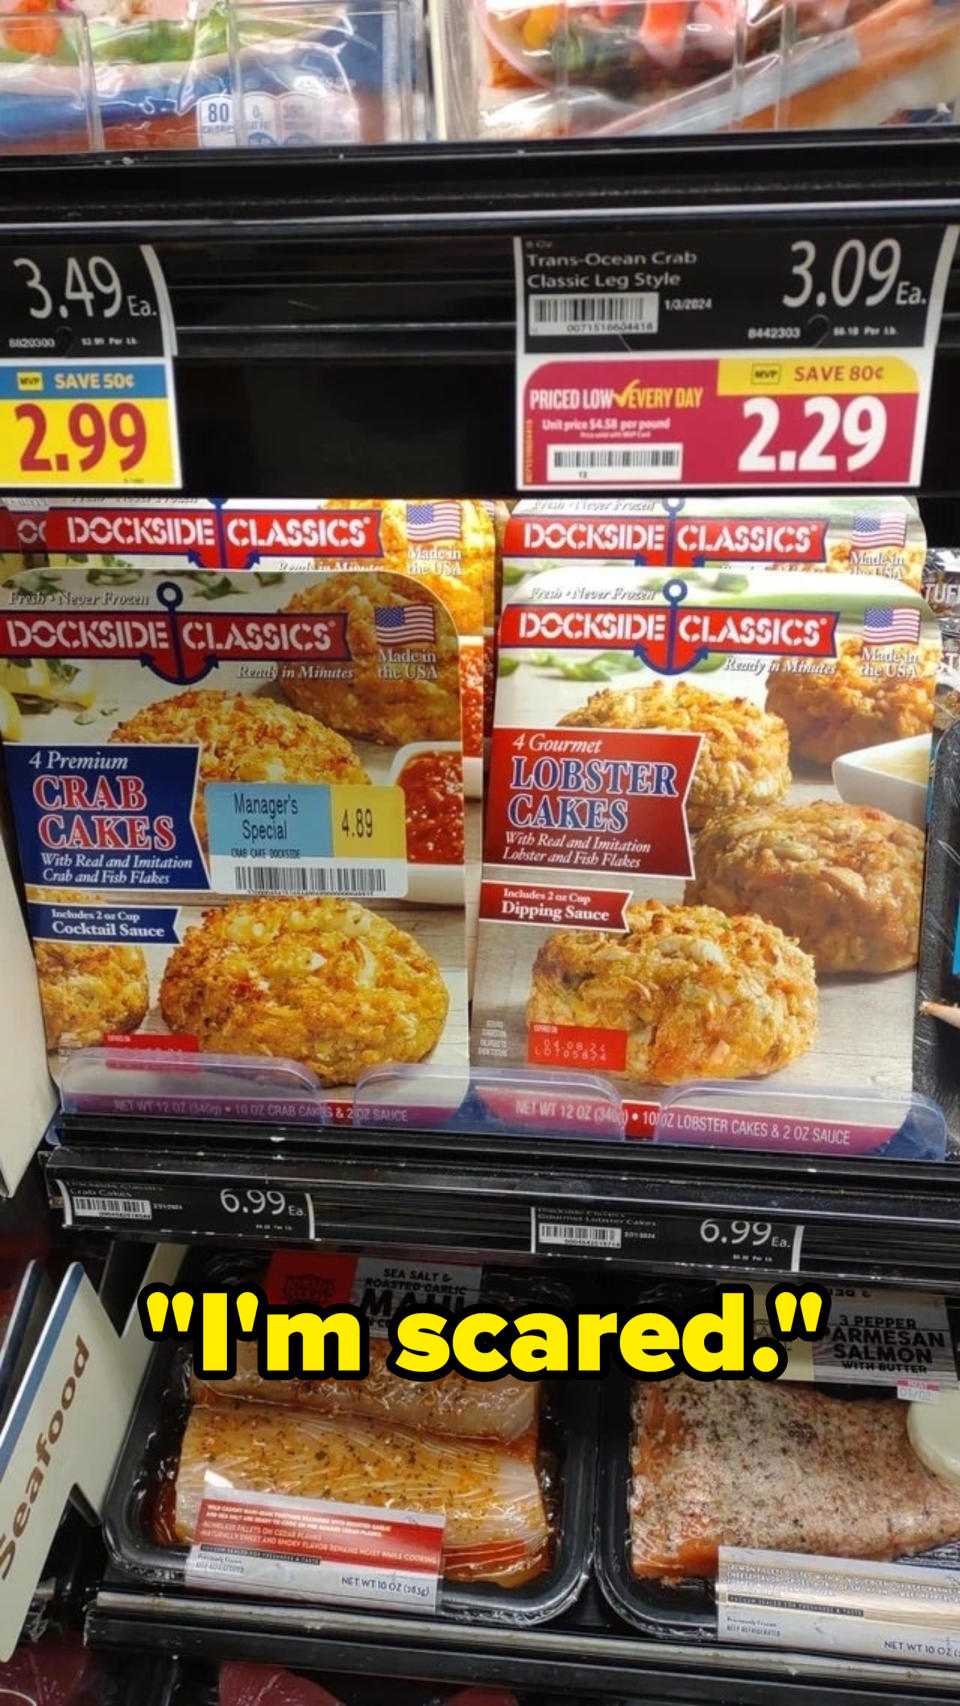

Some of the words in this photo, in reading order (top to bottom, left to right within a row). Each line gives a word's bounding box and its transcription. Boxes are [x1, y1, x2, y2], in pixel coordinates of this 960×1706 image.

[208, 103, 229, 122] 80
[526, 252, 646, 267] Trans-Ocean
[652, 251, 697, 265] Crab
[527, 273, 590, 288] Classic
[595, 273, 630, 289] Leg
[634, 272, 681, 288] Style
[783, 239, 901, 307] 3.09
[896, 281, 927, 305] Ea.
[13, 256, 122, 318] 3.49
[127, 295, 157, 317] Ea.
[748, 328, 801, 340] 8442303
[54, 373, 101, 389] SAVE
[103, 372, 135, 389] 50¢
[754, 370, 778, 379] MVP
[794, 366, 844, 382] SAVE
[849, 365, 884, 381] 80¢
[530, 389, 579, 410] PRICED
[583, 389, 614, 409] LOW
[629, 388, 673, 408] EVERY
[675, 387, 704, 407] DAY
[542, 419, 562, 430] Unit
[564, 419, 588, 432] price
[620, 420, 636, 432] per
[639, 418, 670, 430] pound
[738, 396, 888, 473] 2.29
[14, 402, 147, 472] 2.99
[67, 516, 216, 545] DOCKSIDE
[228, 518, 366, 548] CLASSICS
[524, 523, 665, 550] DOCKSIDE
[677, 524, 811, 553] CLASSICS
[408, 546, 443, 560] Made
[850, 551, 890, 566] Made
[58, 593, 100, 606] Never
[102, 592, 150, 606] Frozen
[925, 583, 960, 603] TUF
[7, 620, 169, 649] DOCKSIDE
[182, 622, 332, 651] CLASSICS
[519, 612, 666, 641] DOCKSIDE
[679, 615, 820, 647] CLASSICS
[378, 649, 420, 662] Made
[422, 649, 437, 663] in
[861, 647, 900, 663] Made
[237, 666, 278, 682] Ready
[281, 666, 295, 678] in
[299, 666, 354, 679] Minutes
[377, 663, 402, 678] the
[405, 664, 439, 679] USA
[724, 657, 767, 675] Ready
[768, 660, 780, 673] in
[782, 659, 836, 675] Minutes
[861, 664, 881, 677] the
[884, 664, 918, 678] USA
[512, 734, 525, 748] 4
[529, 732, 603, 754] Gourmet
[28, 752, 42, 769] 4
[47, 751, 129, 770] Premium
[510, 755, 679, 797] LOBSTER
[32, 774, 148, 811] CRAB
[233, 792, 299, 821] Manager's
[507, 794, 629, 834] CAKES
[38, 814, 177, 851] CAKES
[242, 819, 288, 844] Special
[341, 808, 374, 838] 4.89
[505, 831, 536, 846] With
[537, 834, 564, 848] Real
[566, 836, 590, 849] and
[593, 838, 651, 853] Imitation
[41, 852, 73, 867] With
[75, 854, 104, 867] Real
[105, 856, 131, 868] and
[133, 855, 194, 869] Imitation
[502, 847, 547, 863] Lobster
[548, 850, 575, 864] and
[573, 852, 600, 866] Fish
[601, 855, 641, 869] Flakes
[42, 868, 73, 883] Crab
[74, 870, 98, 883] and
[101, 870, 128, 884] Fish
[129, 871, 171, 885] Flakes
[503, 888, 546, 901] Includes
[547, 892, 555, 901] 2
[555, 894, 567, 902] oz
[569, 892, 591, 906] Cup
[52, 909, 95, 921] Includes
[95, 911, 103, 921] 2
[104, 913, 116, 921] oz
[117, 910, 141, 923] Cup
[501, 901, 563, 921] Dipping
[565, 906, 610, 922] Sauce
[52, 921, 117, 937] Cocktail
[119, 923, 165, 938] Sauce
[114, 1100, 134, 1112] NET
[137, 1101, 153, 1113] WT
[156, 1102, 169, 1113] 12
[172, 1103, 187, 1114] OZ
[235, 1105, 248, 1116] 10
[250, 1105, 265, 1117] OZ
[267, 1106, 297, 1117] CRAB
[335, 1107, 345, 1119] &
[373, 1109, 408, 1122] SAUCE
[515, 1099, 537, 1115] NET
[539, 1102, 557, 1117] WT
[560, 1103, 574, 1119] 12
[576, 1104, 592, 1120] OZ
[643, 1110, 657, 1126] 10
[659, 1112, 674, 1128] OZ
[677, 1113, 729, 1134] LOBSTER
[731, 1119, 769, 1138] CAKES
[770, 1123, 780, 1139] &
[782, 1124, 791, 1140] 2
[793, 1125, 810, 1142] OZ
[812, 1127, 851, 1145] SAUCE
[220, 1188, 286, 1215] 6.99
[700, 1219, 772, 1246] 6.99
[771, 1236, 792, 1248] Ea.
[384, 1267, 406, 1279] SEA
[410, 1269, 439, 1283] SALT
[365, 1277, 421, 1292] ROASTED
[424, 1282, 467, 1296] GARLIC
[839, 1314, 849, 1327] 3
[853, 1315, 917, 1330] PEPPER
[833, 1343, 933, 1364] SALMON
[841, 1360, 875, 1370] WITH
[878, 1362, 928, 1374] BUTTER
[0, 1335, 90, 1581] Seafood
[341, 1576, 359, 1587] NET
[361, 1578, 376, 1589] WT
[377, 1581, 387, 1590] 10
[388, 1582, 402, 1592] OZ
[884, 1640, 904, 1650] NET
[905, 1643, 923, 1652] WT
[925, 1645, 936, 1654] 10
[937, 1647, 952, 1656] OZ
